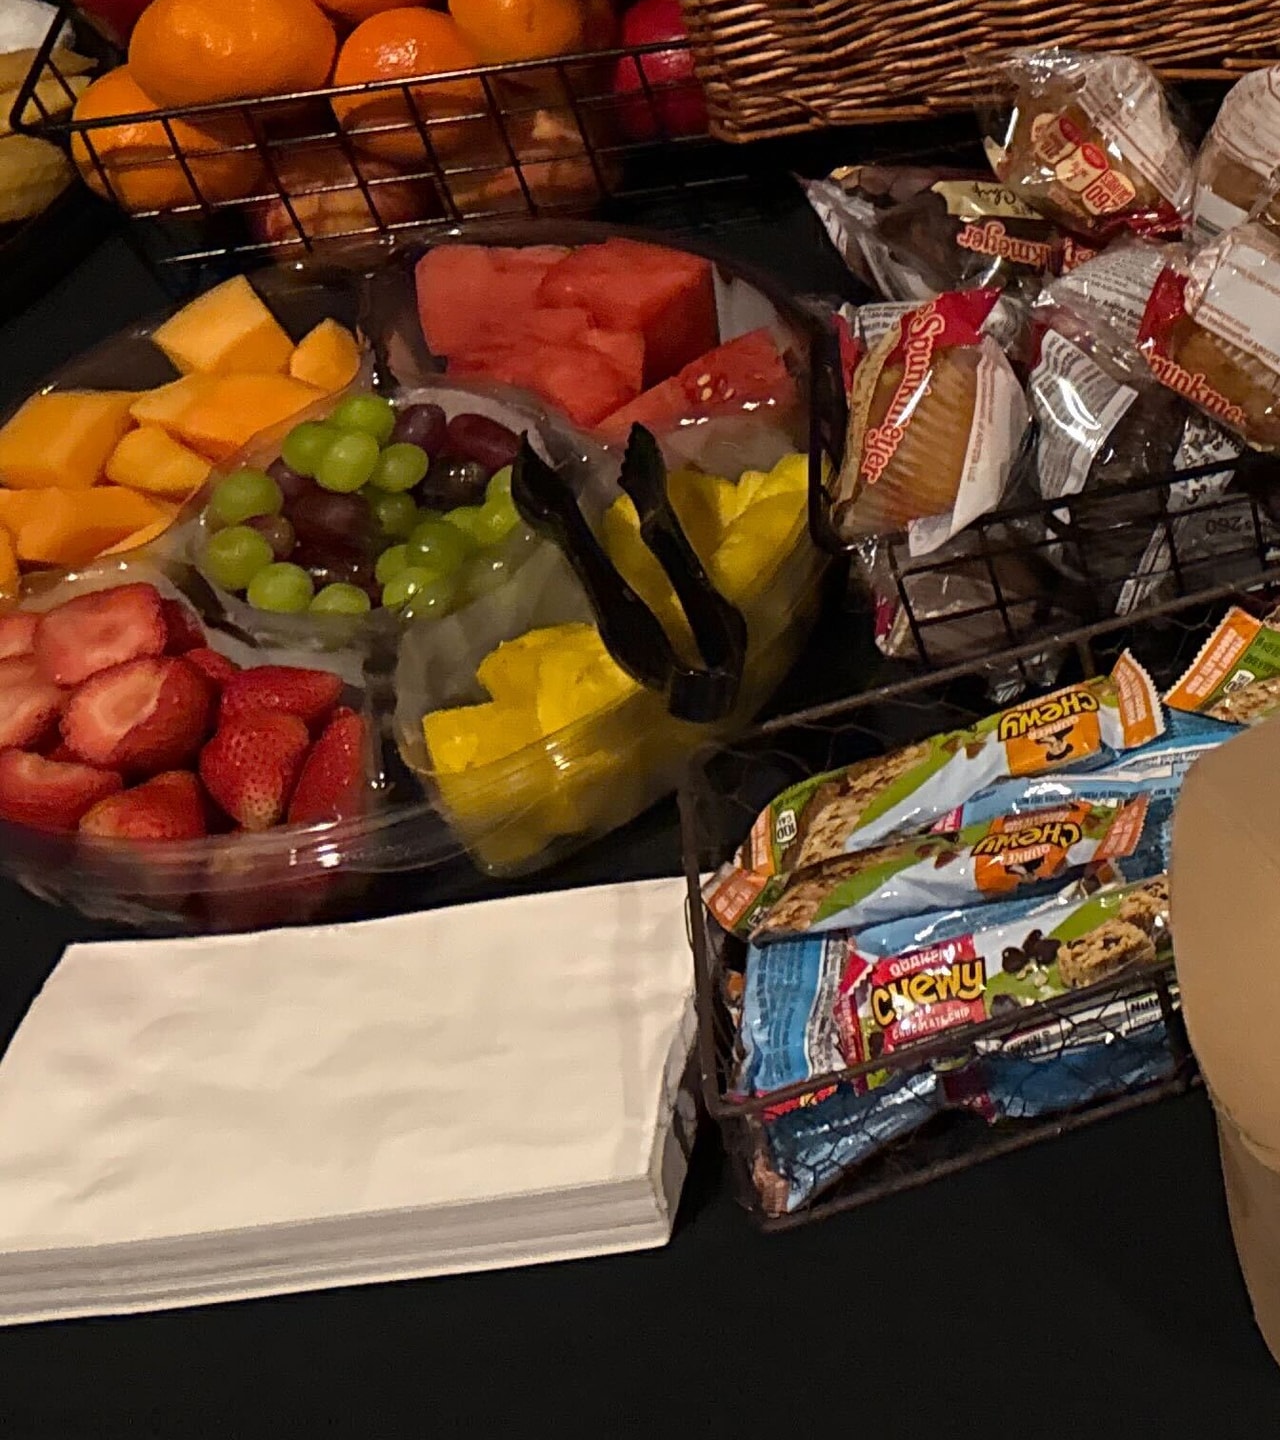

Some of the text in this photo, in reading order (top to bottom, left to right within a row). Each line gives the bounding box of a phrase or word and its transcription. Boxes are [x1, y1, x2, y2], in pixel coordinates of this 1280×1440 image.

[1085, 185, 1111, 214] 260
[861, 312, 946, 485] Spunkmeyer
[776, 823, 798, 842] 100
[1003, 845, 1052, 868] QUAKE
[888, 942, 964, 979] QUAKE
